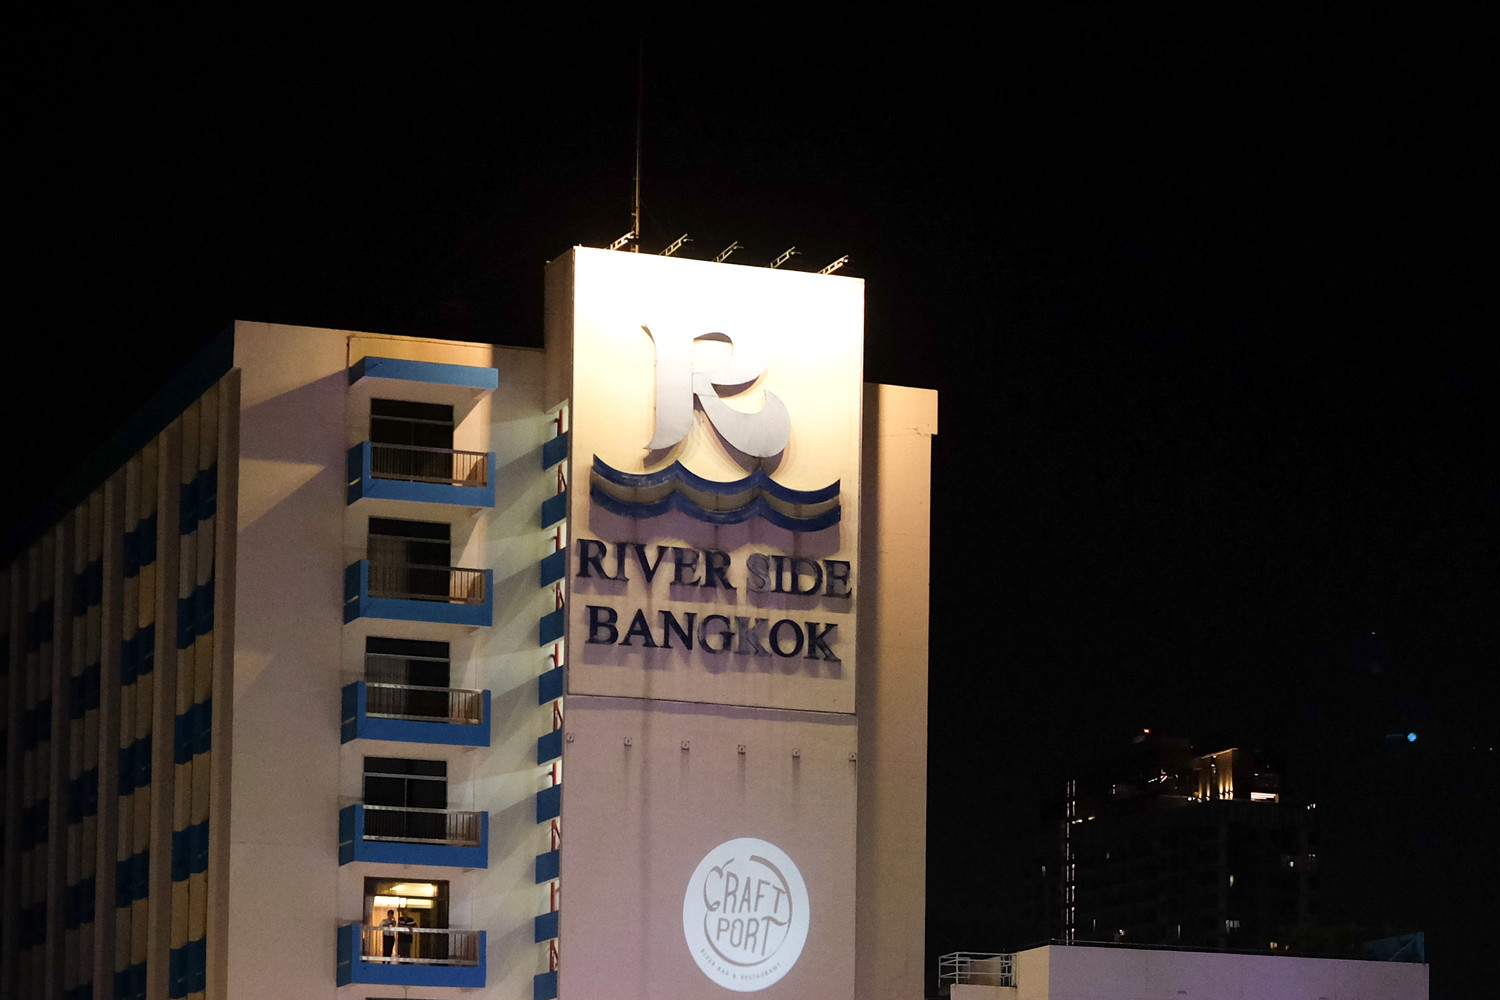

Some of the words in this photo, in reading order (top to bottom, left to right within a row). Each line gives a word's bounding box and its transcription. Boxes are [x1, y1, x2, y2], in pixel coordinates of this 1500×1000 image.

[576, 538, 736, 592] RIVER
[746, 554, 852, 598] SIDE
[585, 605, 841, 662] BANGKOK
[703, 860, 787, 914] CRAFT
[716, 916, 788, 956] PORT
